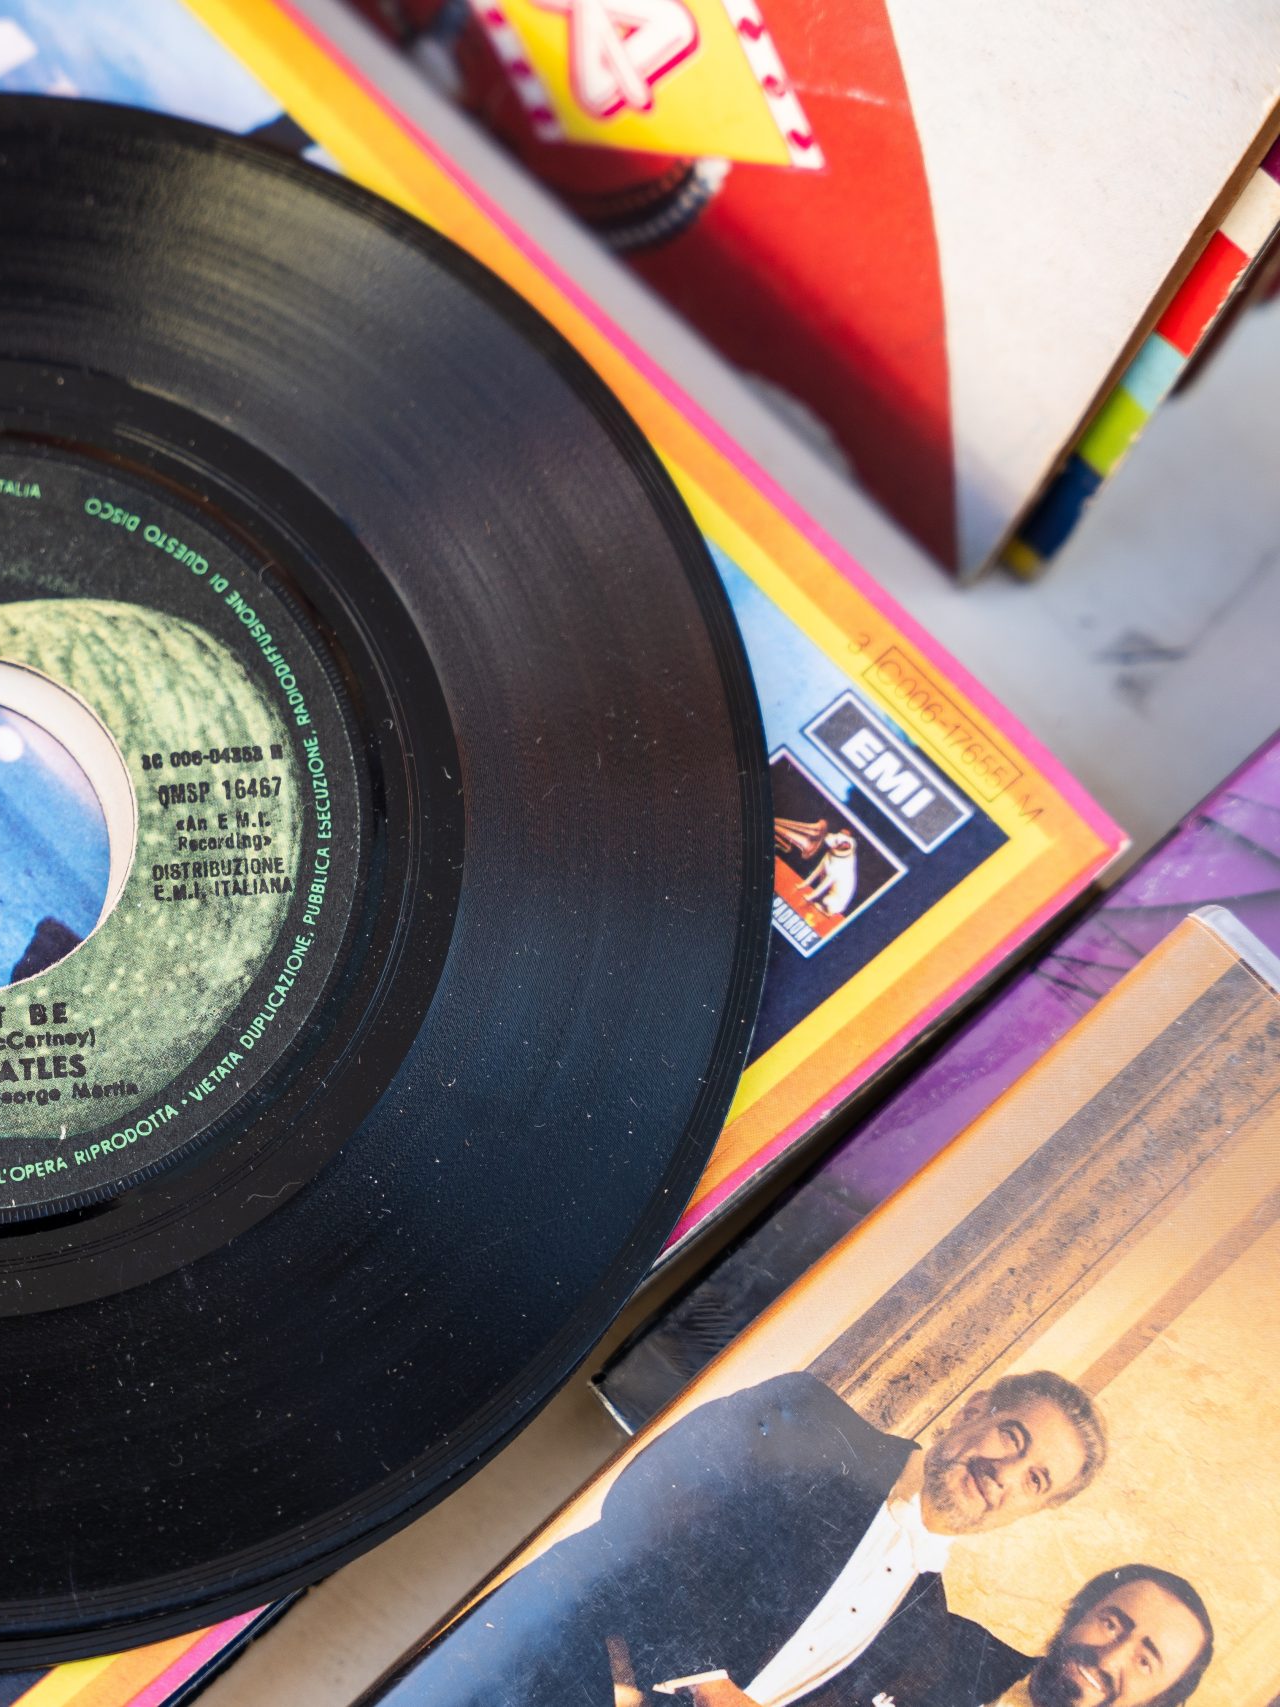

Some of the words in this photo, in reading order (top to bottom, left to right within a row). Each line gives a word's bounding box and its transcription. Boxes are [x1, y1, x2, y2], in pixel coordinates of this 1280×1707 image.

[84, 498, 141, 532] DISCO
[143, 525, 209, 576] QUESTO
[209, 573, 229, 593] DI
[224, 590, 312, 727] RADIODIFFUSIONE
[847, 634, 870, 655] 3
[840, 727, 937, 820] EMI
[158, 782, 210, 808] QMSP
[222, 776, 282, 800] 16467
[152, 857, 285, 881] DISTRIBUZIONE
[215, 877, 293, 897] ITALIANA
[302, 847, 330, 926] PUBBLICA
[29, 1002, 68, 1026] BE
[72, 1080, 139, 1100] Martin
[188, 1051, 244, 1101] VIETATA
[74, 1104, 179, 1166] RIPRODOTTA
